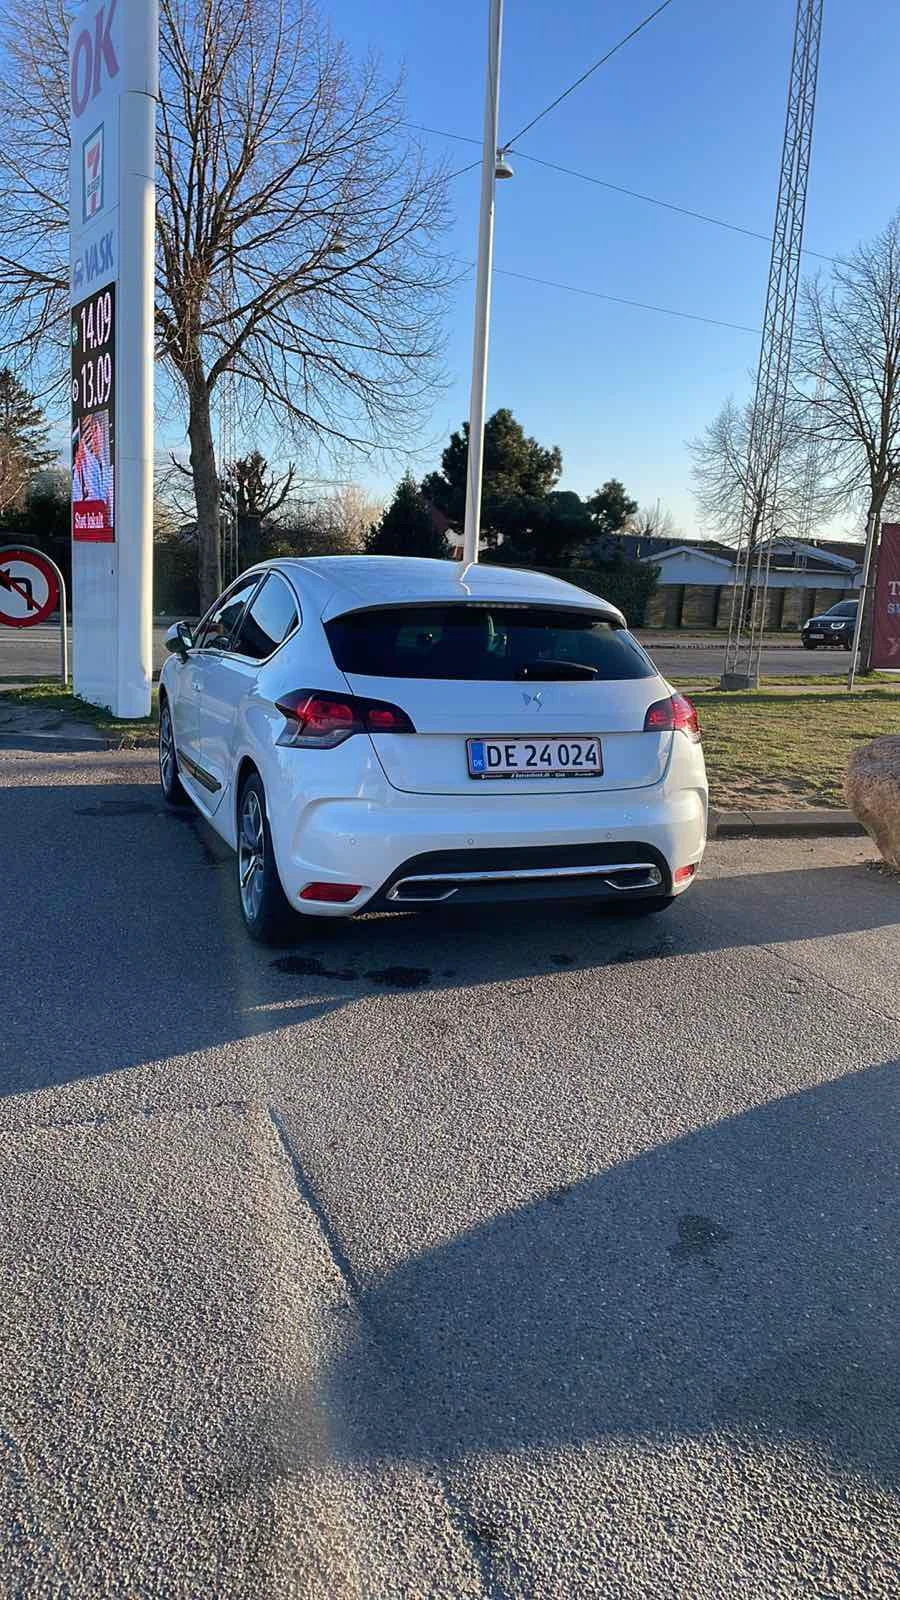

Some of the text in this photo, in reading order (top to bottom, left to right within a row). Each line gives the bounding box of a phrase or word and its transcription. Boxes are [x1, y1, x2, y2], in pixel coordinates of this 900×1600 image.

[72, 0, 119, 117] OK
[85, 232, 113, 282] VASK
[81, 292, 111, 352] 14.09
[81, 353, 111, 408] 13.09
[487, 745, 517, 767] DE
[524, 744, 552, 766] 24
[557, 744, 597, 766] 024
